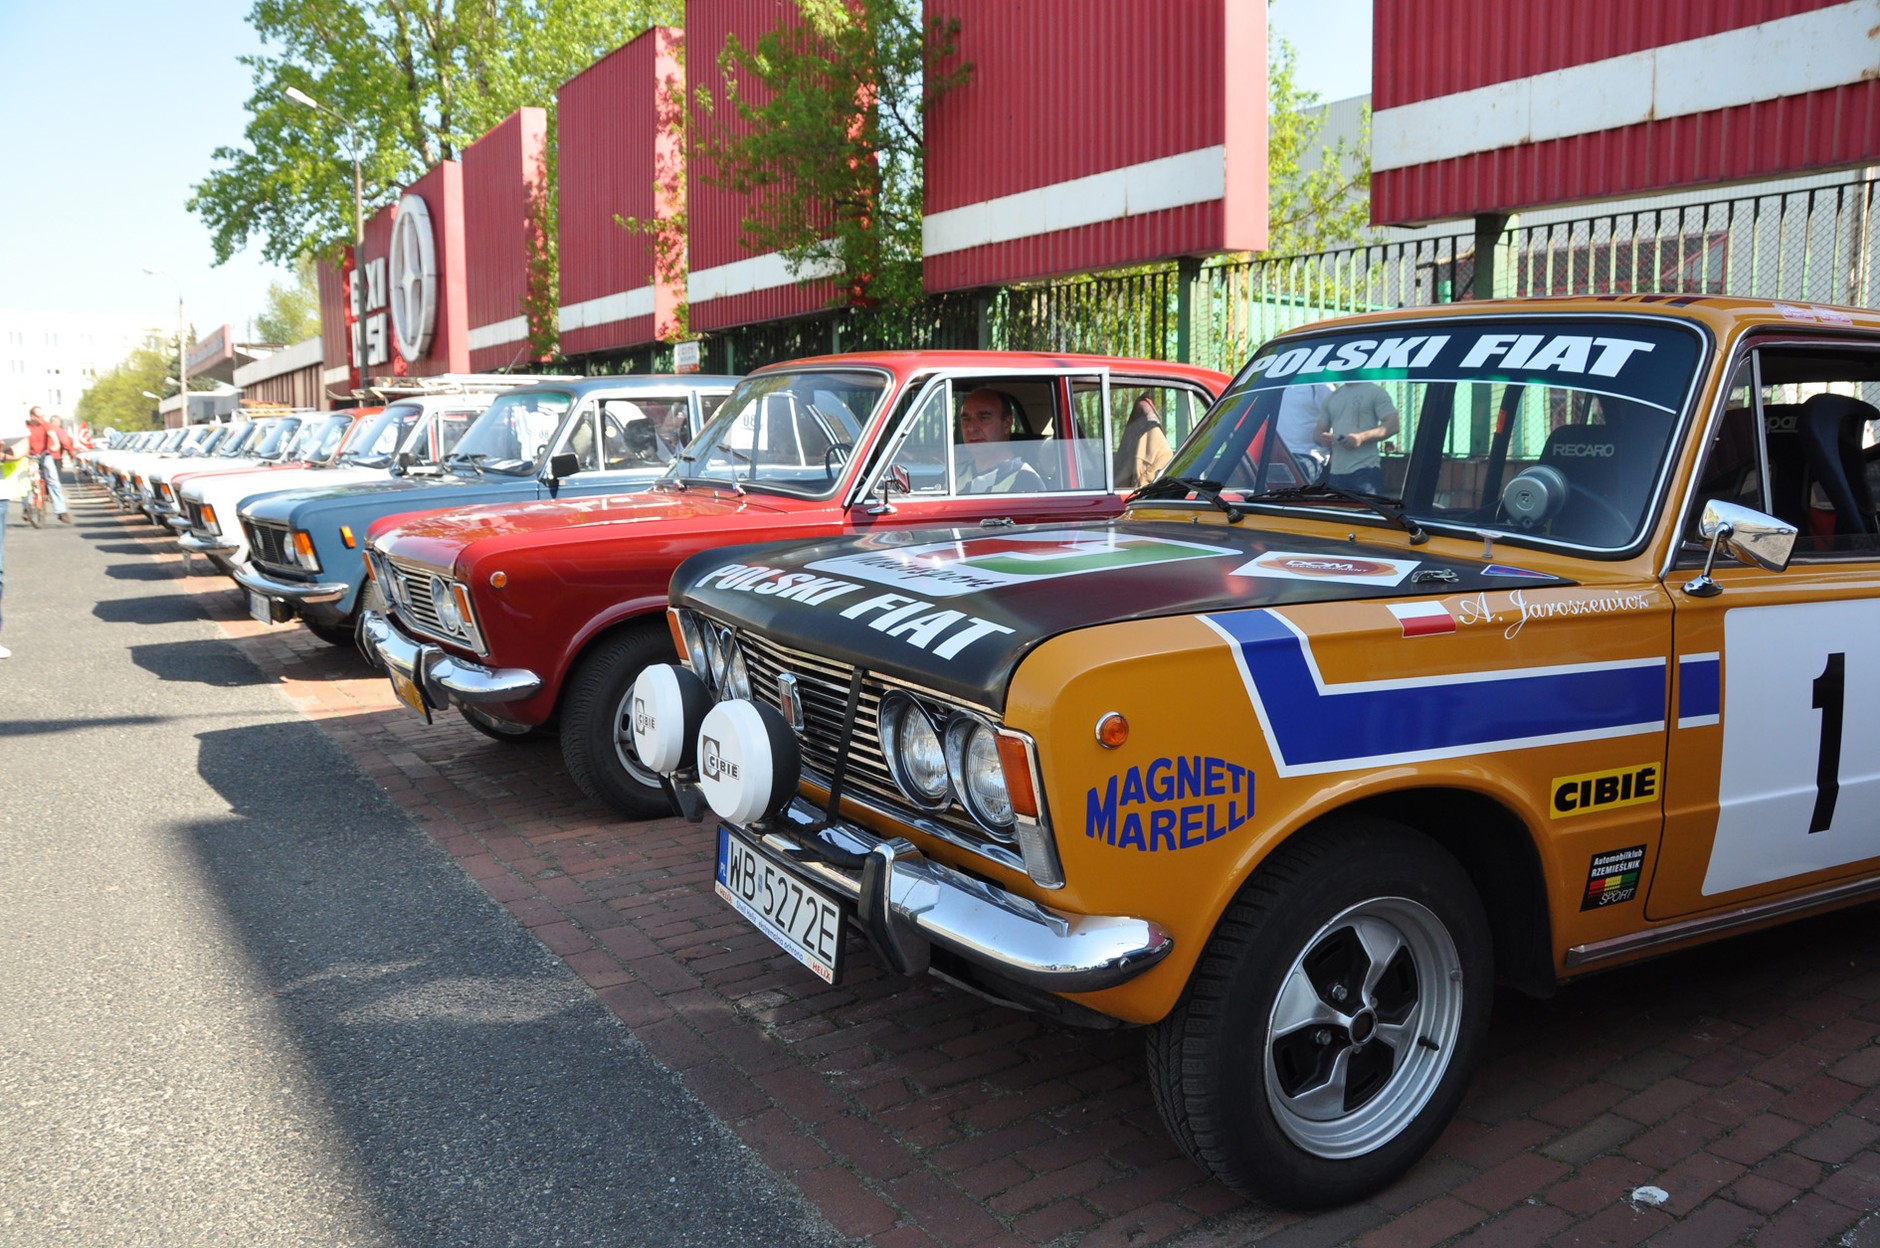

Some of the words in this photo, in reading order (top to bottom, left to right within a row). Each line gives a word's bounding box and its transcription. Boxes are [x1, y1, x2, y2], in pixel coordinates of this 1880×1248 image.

[1235, 335, 1451, 388] POLSKI
[1459, 333, 1656, 378] FIAT
[1552, 443, 1615, 458] RECARO
[695, 563, 866, 606] POLSKI
[839, 593, 1017, 660] FIAT
[1458, 591, 1504, 625] A.
[1504, 589, 1649, 640] Jaroszewicz
[1808, 652, 1845, 834] 1
[1086, 756, 1255, 838] MAGNETI
[1086, 780, 1255, 852] MARELLI
[1591, 860, 1640, 877] RZEMIEŚLNIK
[1594, 849, 1643, 866] Automobilklub
[763, 865, 836, 963] 5272E
[1599, 887, 1634, 905] SPORT
[812, 962, 831, 981] HELIX
